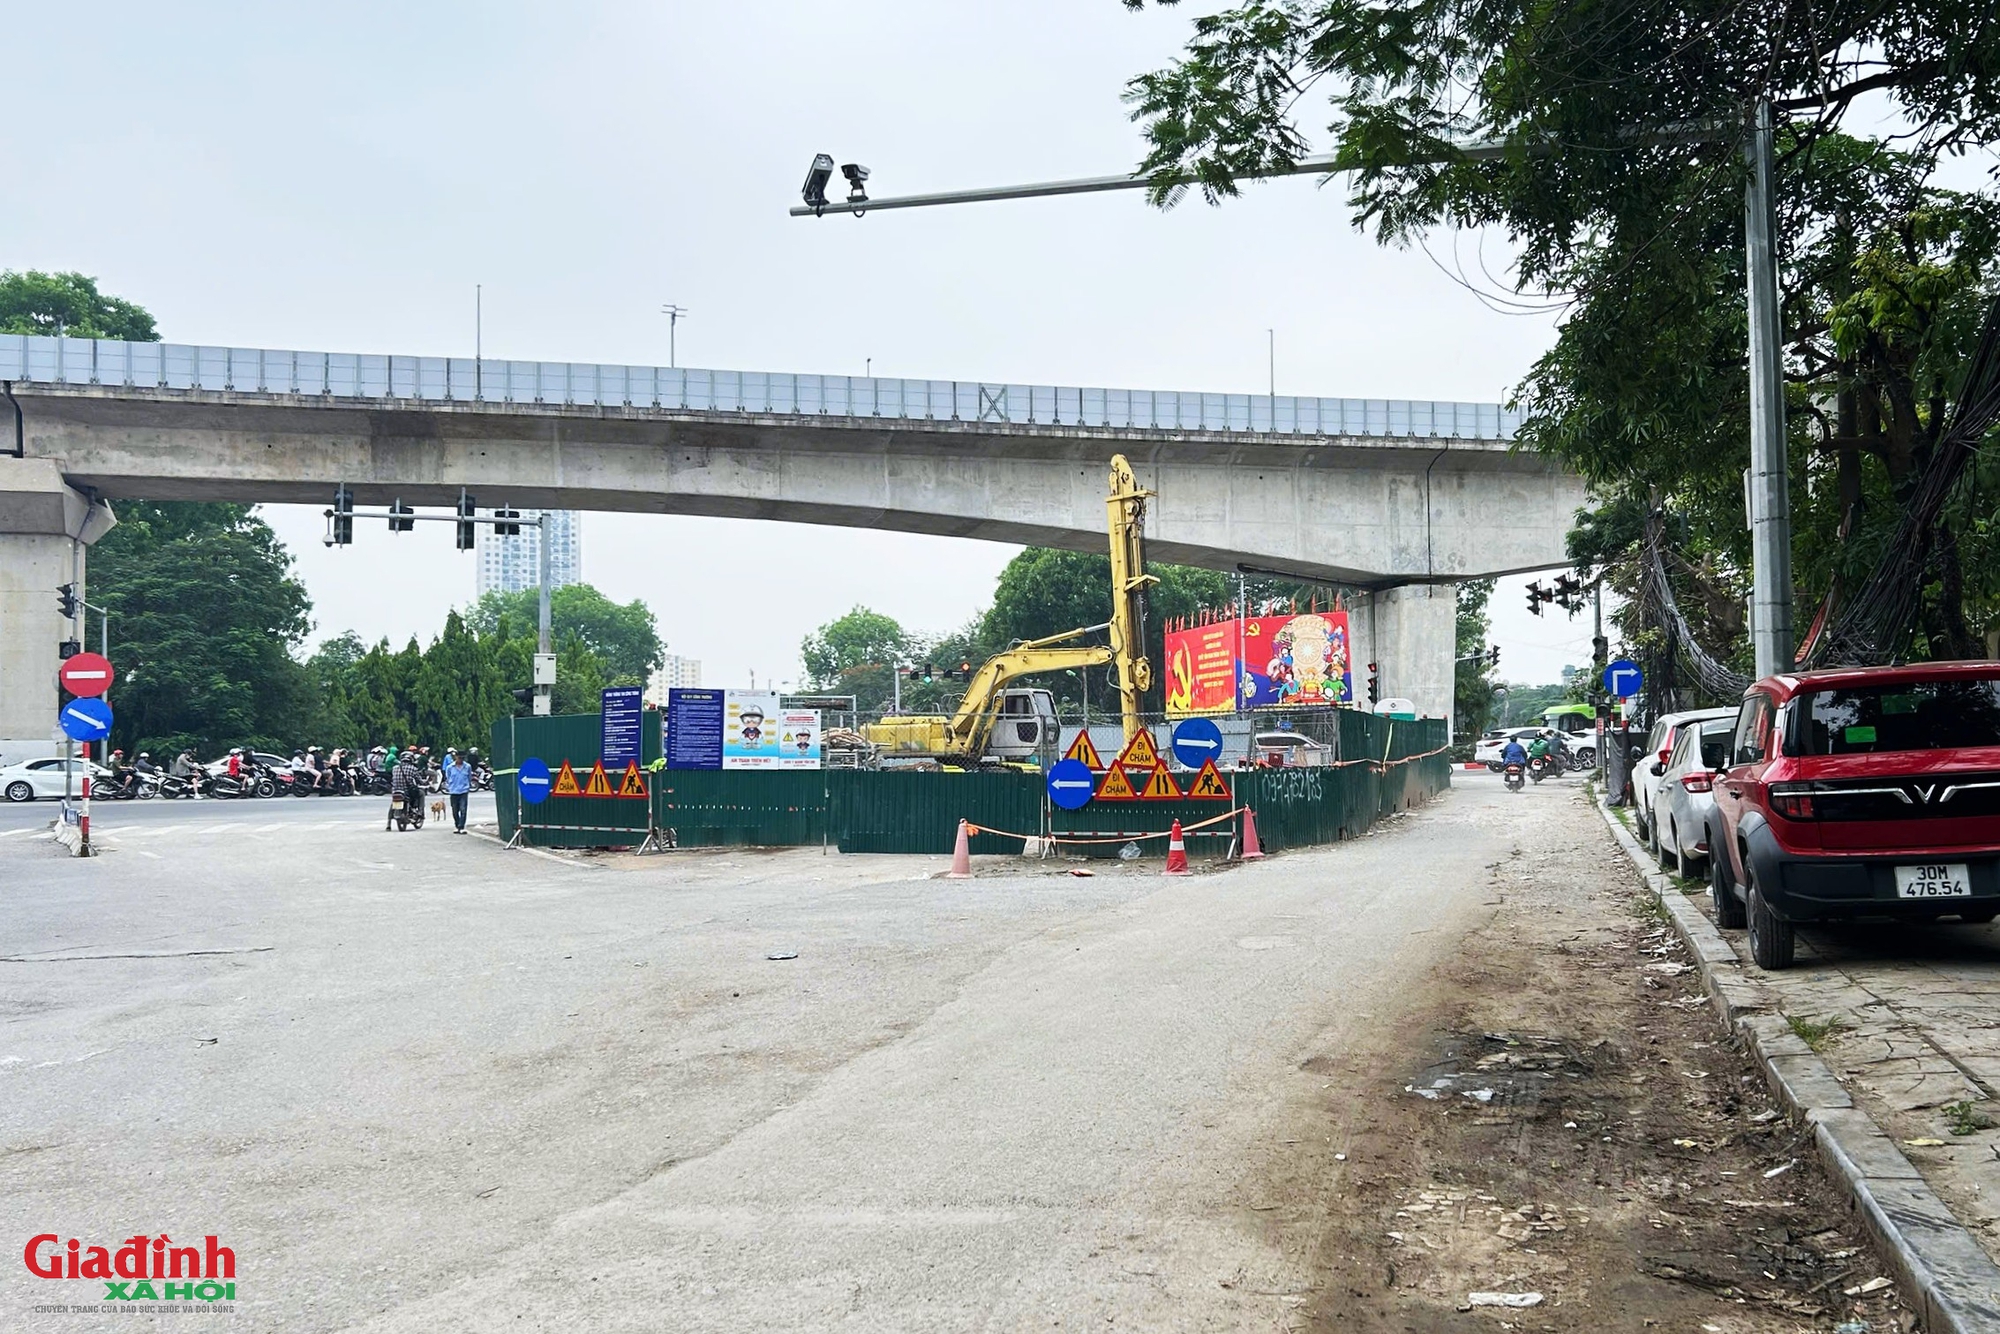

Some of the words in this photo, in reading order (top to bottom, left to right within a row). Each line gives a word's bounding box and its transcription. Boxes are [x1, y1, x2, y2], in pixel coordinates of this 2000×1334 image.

[1137, 741, 1145, 750] ĐI
[1112, 772, 1120, 781] ĐI
[1916, 866, 1948, 880] 30M
[1906, 881, 1963, 896] 476.54
